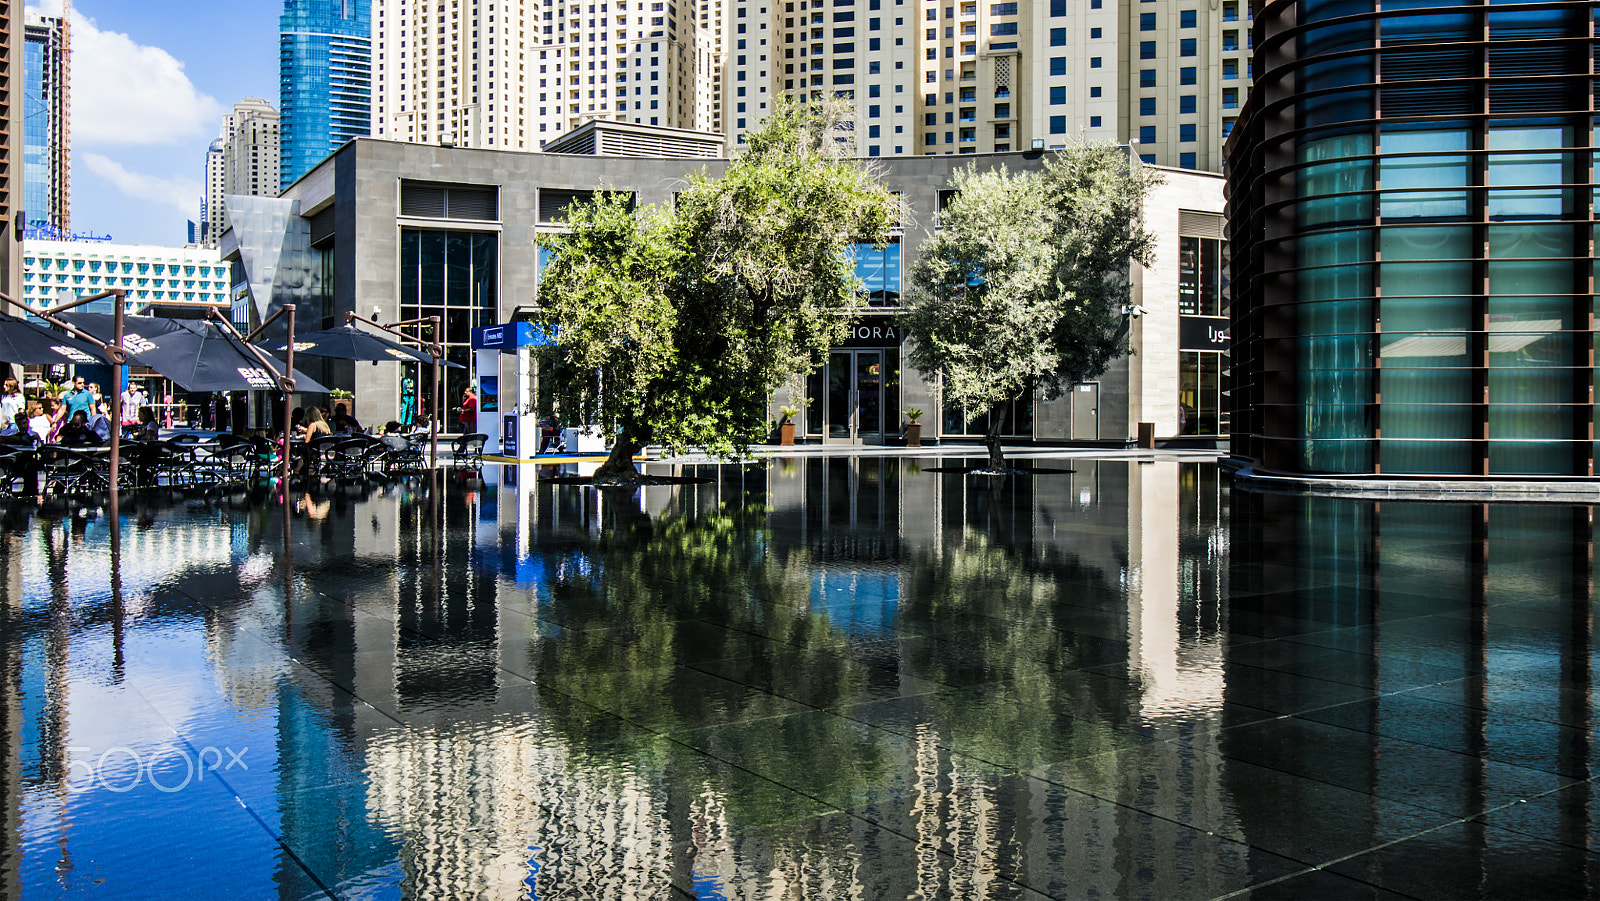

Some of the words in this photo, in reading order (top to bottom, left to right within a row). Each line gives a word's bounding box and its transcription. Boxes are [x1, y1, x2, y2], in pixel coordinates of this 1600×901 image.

[122, 333, 156, 352] BIG
[1208, 325, 1231, 343] ورا
[237, 367, 271, 379] BIG
